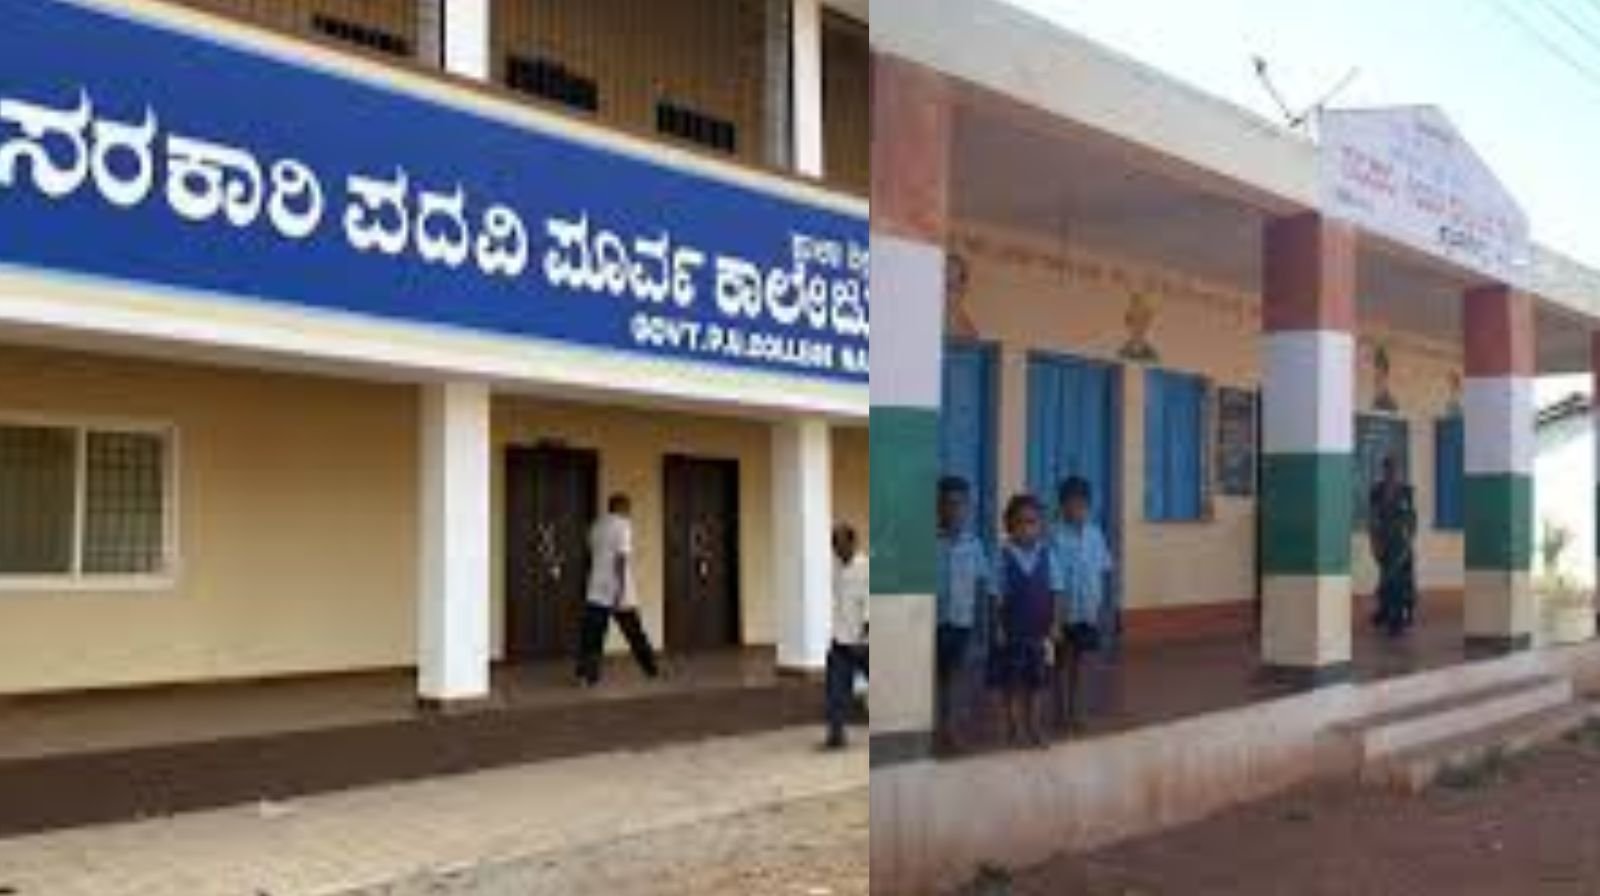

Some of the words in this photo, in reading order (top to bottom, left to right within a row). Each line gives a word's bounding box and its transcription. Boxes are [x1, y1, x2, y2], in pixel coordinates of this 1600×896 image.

[0, 88, 322, 238] ಸರಕಾರಿ
[344, 166, 528, 276] ಪದವಿ
[543, 211, 705, 307] ಪೂರ್ವ
